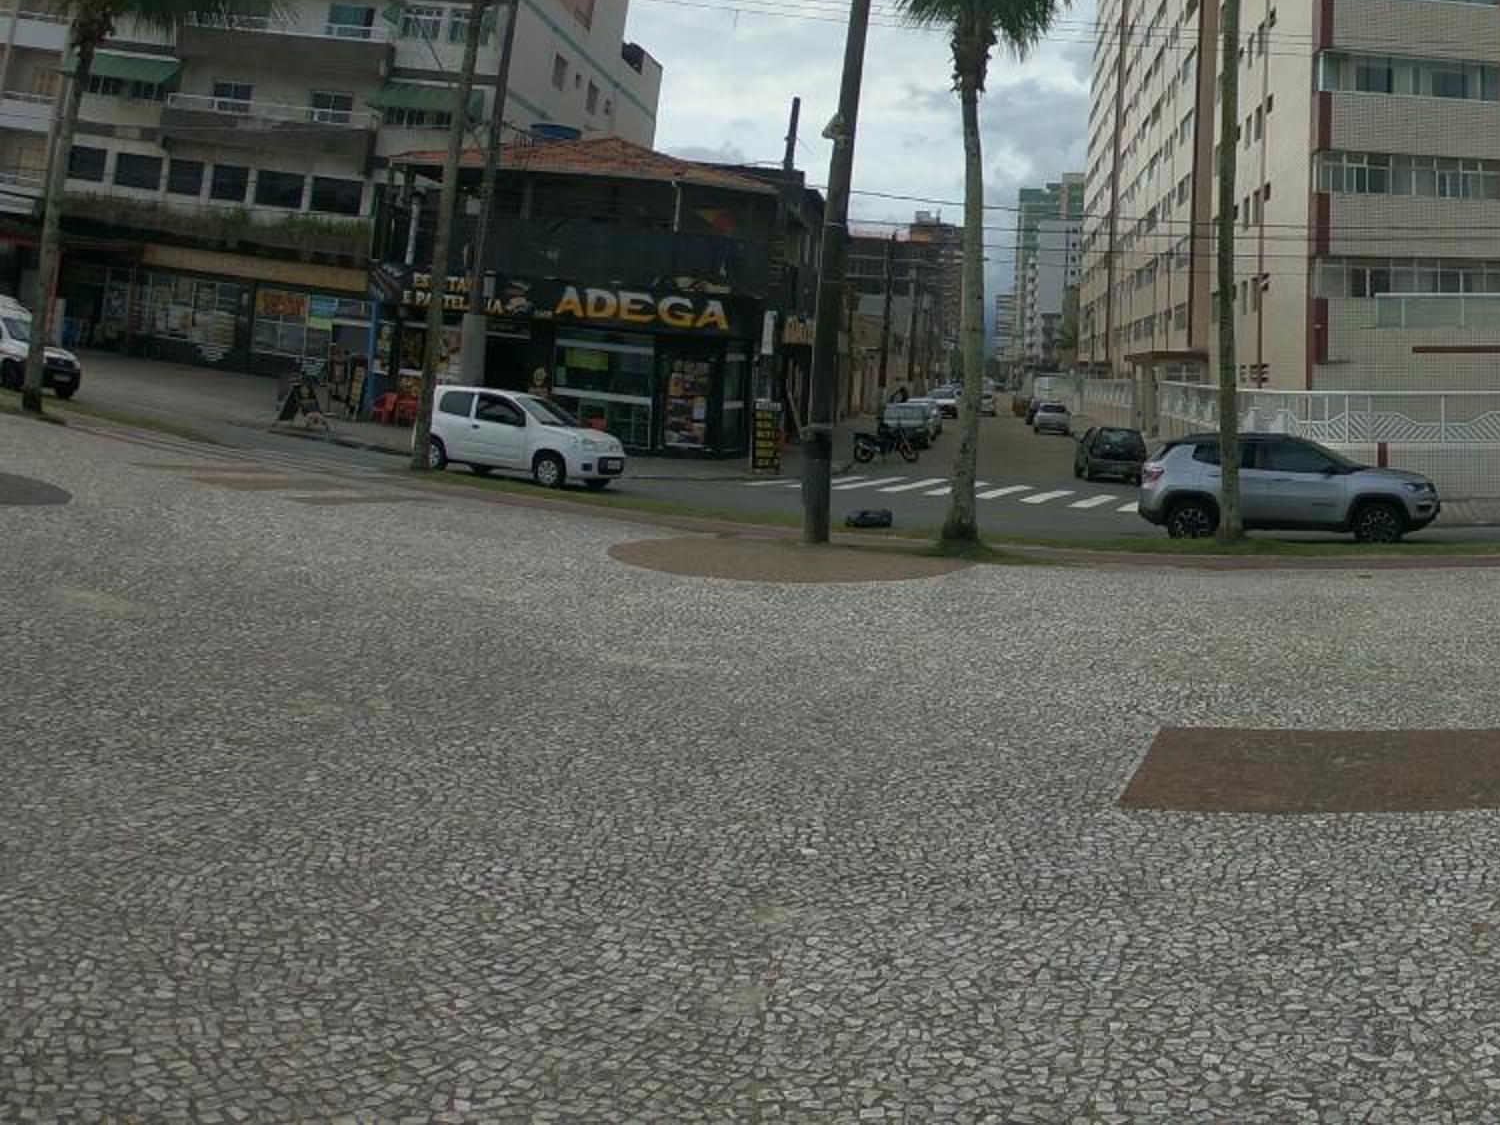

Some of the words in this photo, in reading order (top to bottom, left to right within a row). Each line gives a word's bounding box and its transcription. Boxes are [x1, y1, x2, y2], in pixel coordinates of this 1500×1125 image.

[402, 290, 411, 305] E
[415, 291, 503, 315] PATELIA
[555, 285, 729, 331] ADEGA
